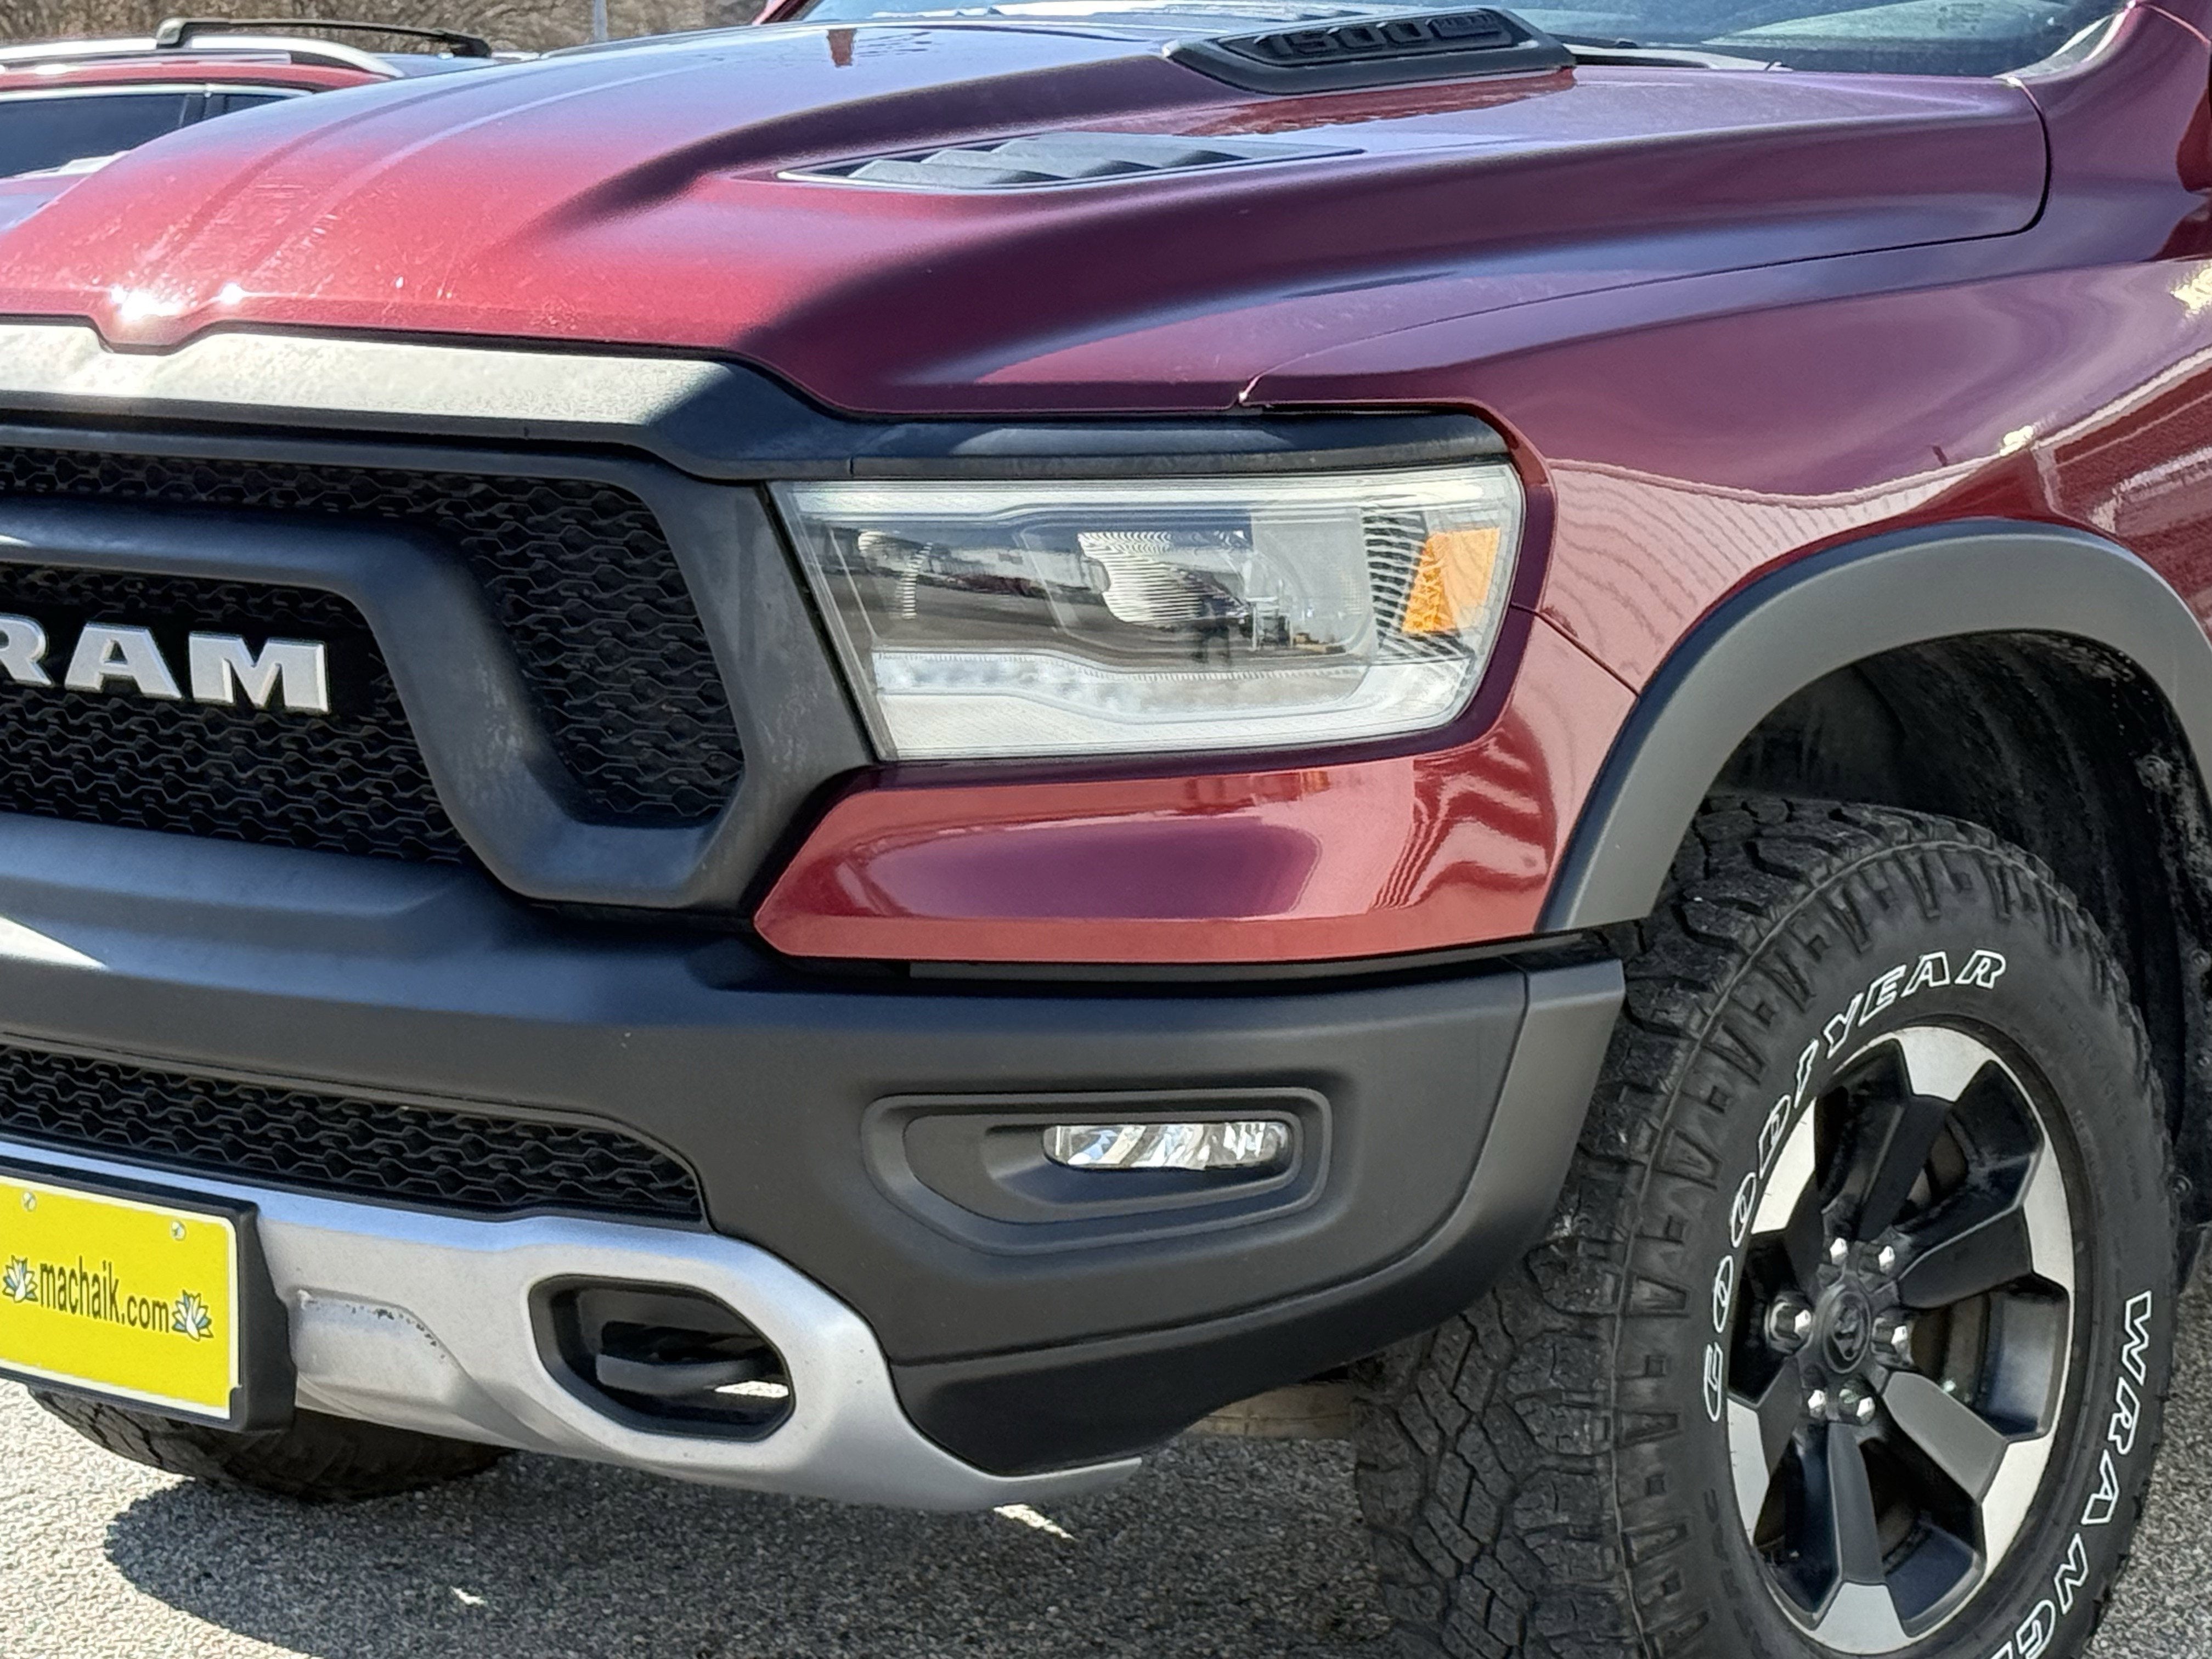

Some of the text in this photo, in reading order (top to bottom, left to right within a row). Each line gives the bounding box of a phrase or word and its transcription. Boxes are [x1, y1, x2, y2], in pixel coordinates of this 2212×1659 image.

[1264, 19, 1431, 55] 1500
[40, 1255, 170, 1333] machaik.com
[1703, 949, 2006, 1422] GOODYEAR
[1990, 1290, 2152, 1659] WRANG
